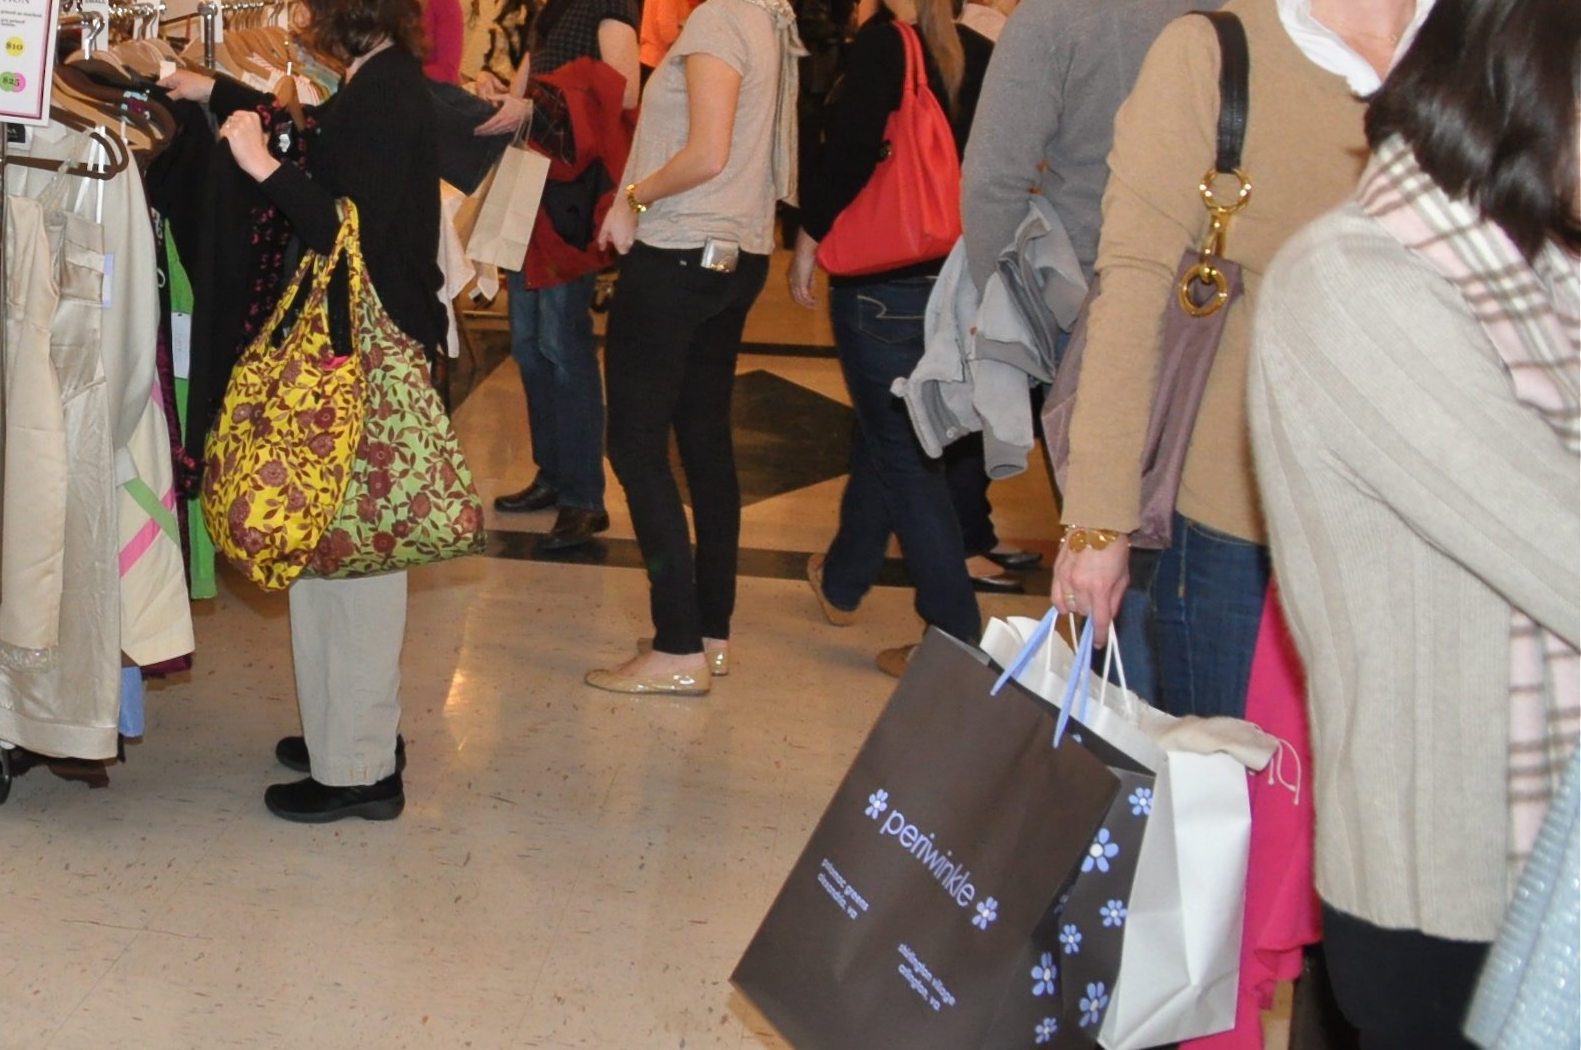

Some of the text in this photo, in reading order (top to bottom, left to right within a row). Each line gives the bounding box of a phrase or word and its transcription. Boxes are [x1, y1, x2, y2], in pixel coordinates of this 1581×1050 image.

[5, 41, 23, 52] $10
[2, 76, 21, 88] $25
[880, 809, 975, 907] periwinkle
[932, 978, 956, 1007] village
